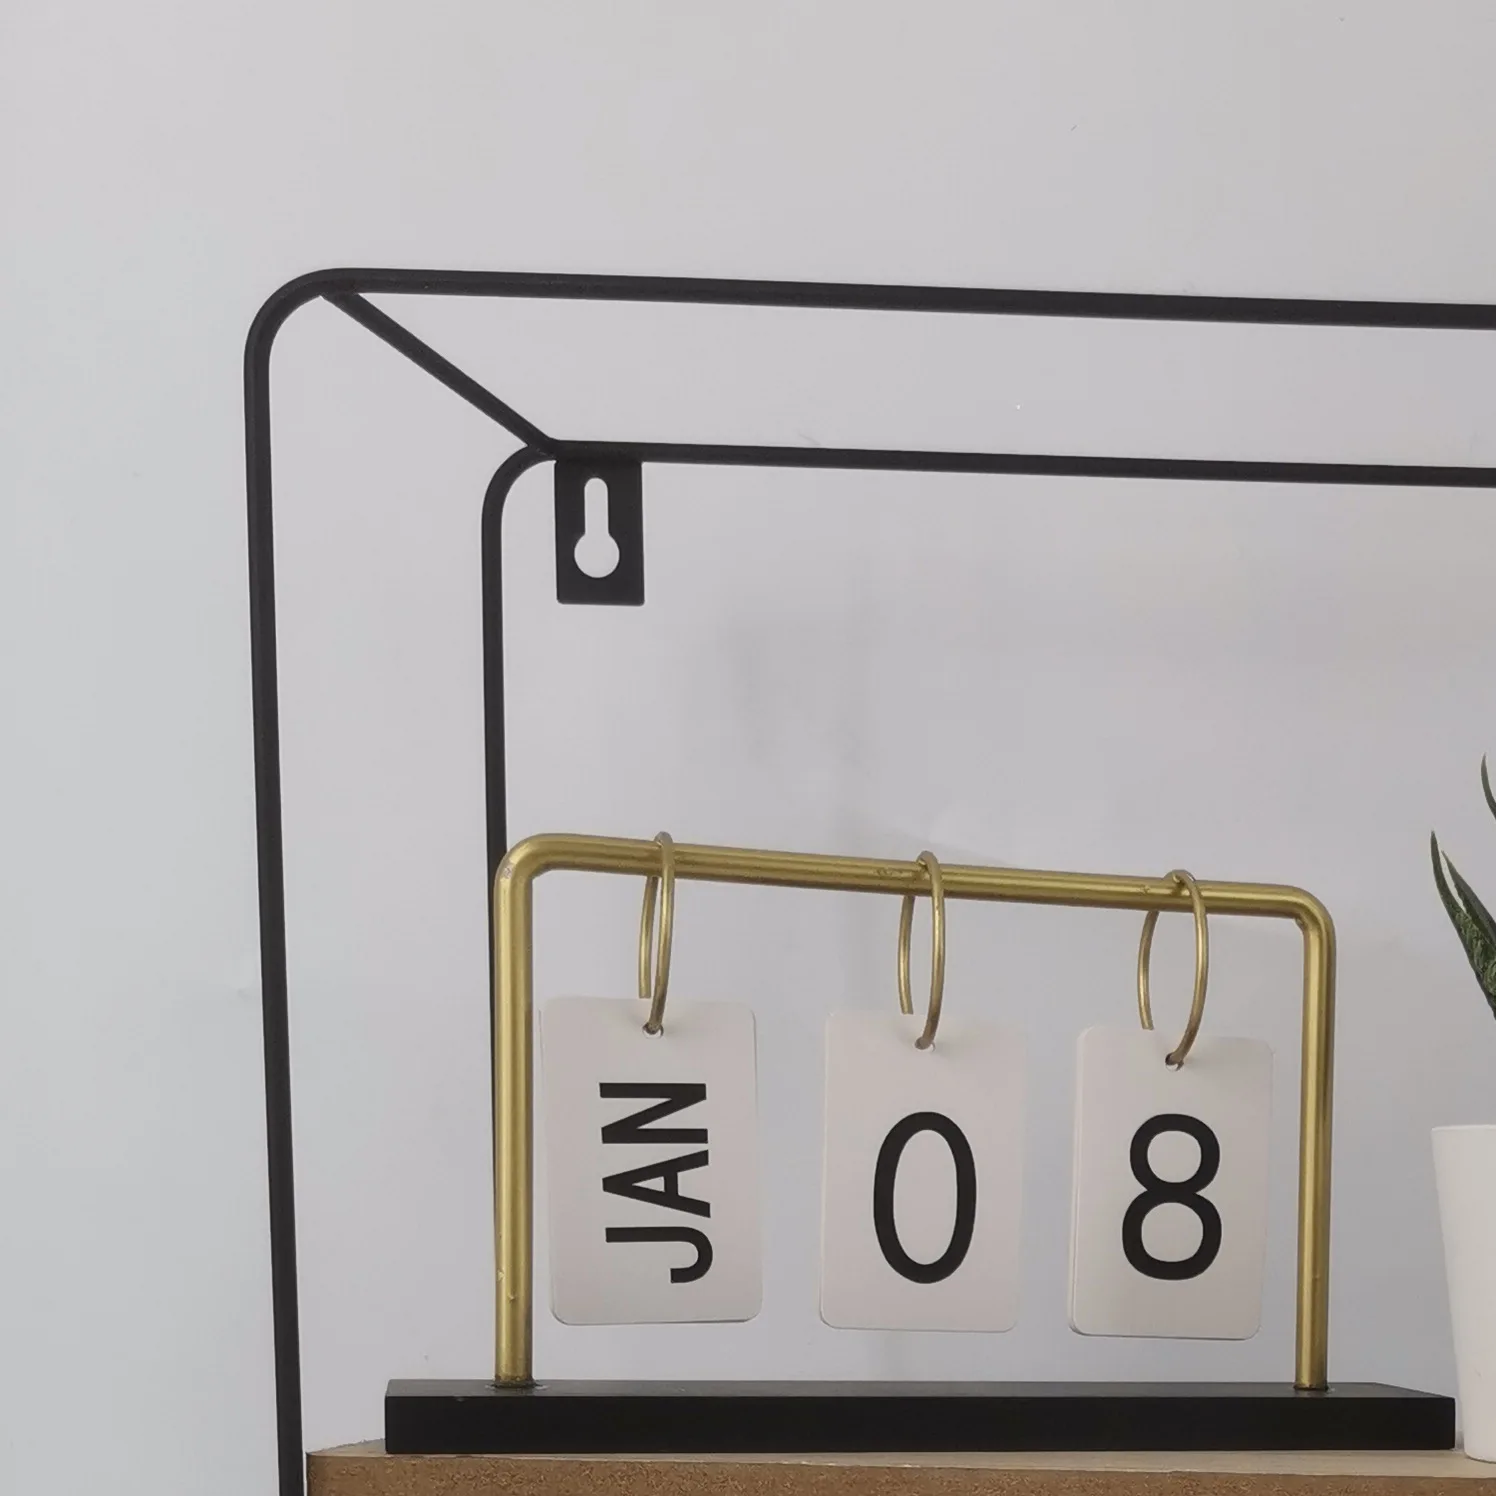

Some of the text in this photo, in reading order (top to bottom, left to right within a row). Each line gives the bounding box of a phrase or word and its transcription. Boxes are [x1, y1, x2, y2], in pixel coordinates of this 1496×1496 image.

[599, 1082, 714, 1285] JAN
[873, 1111, 977, 1284] 0
[1122, 1113, 1223, 1281] 8
